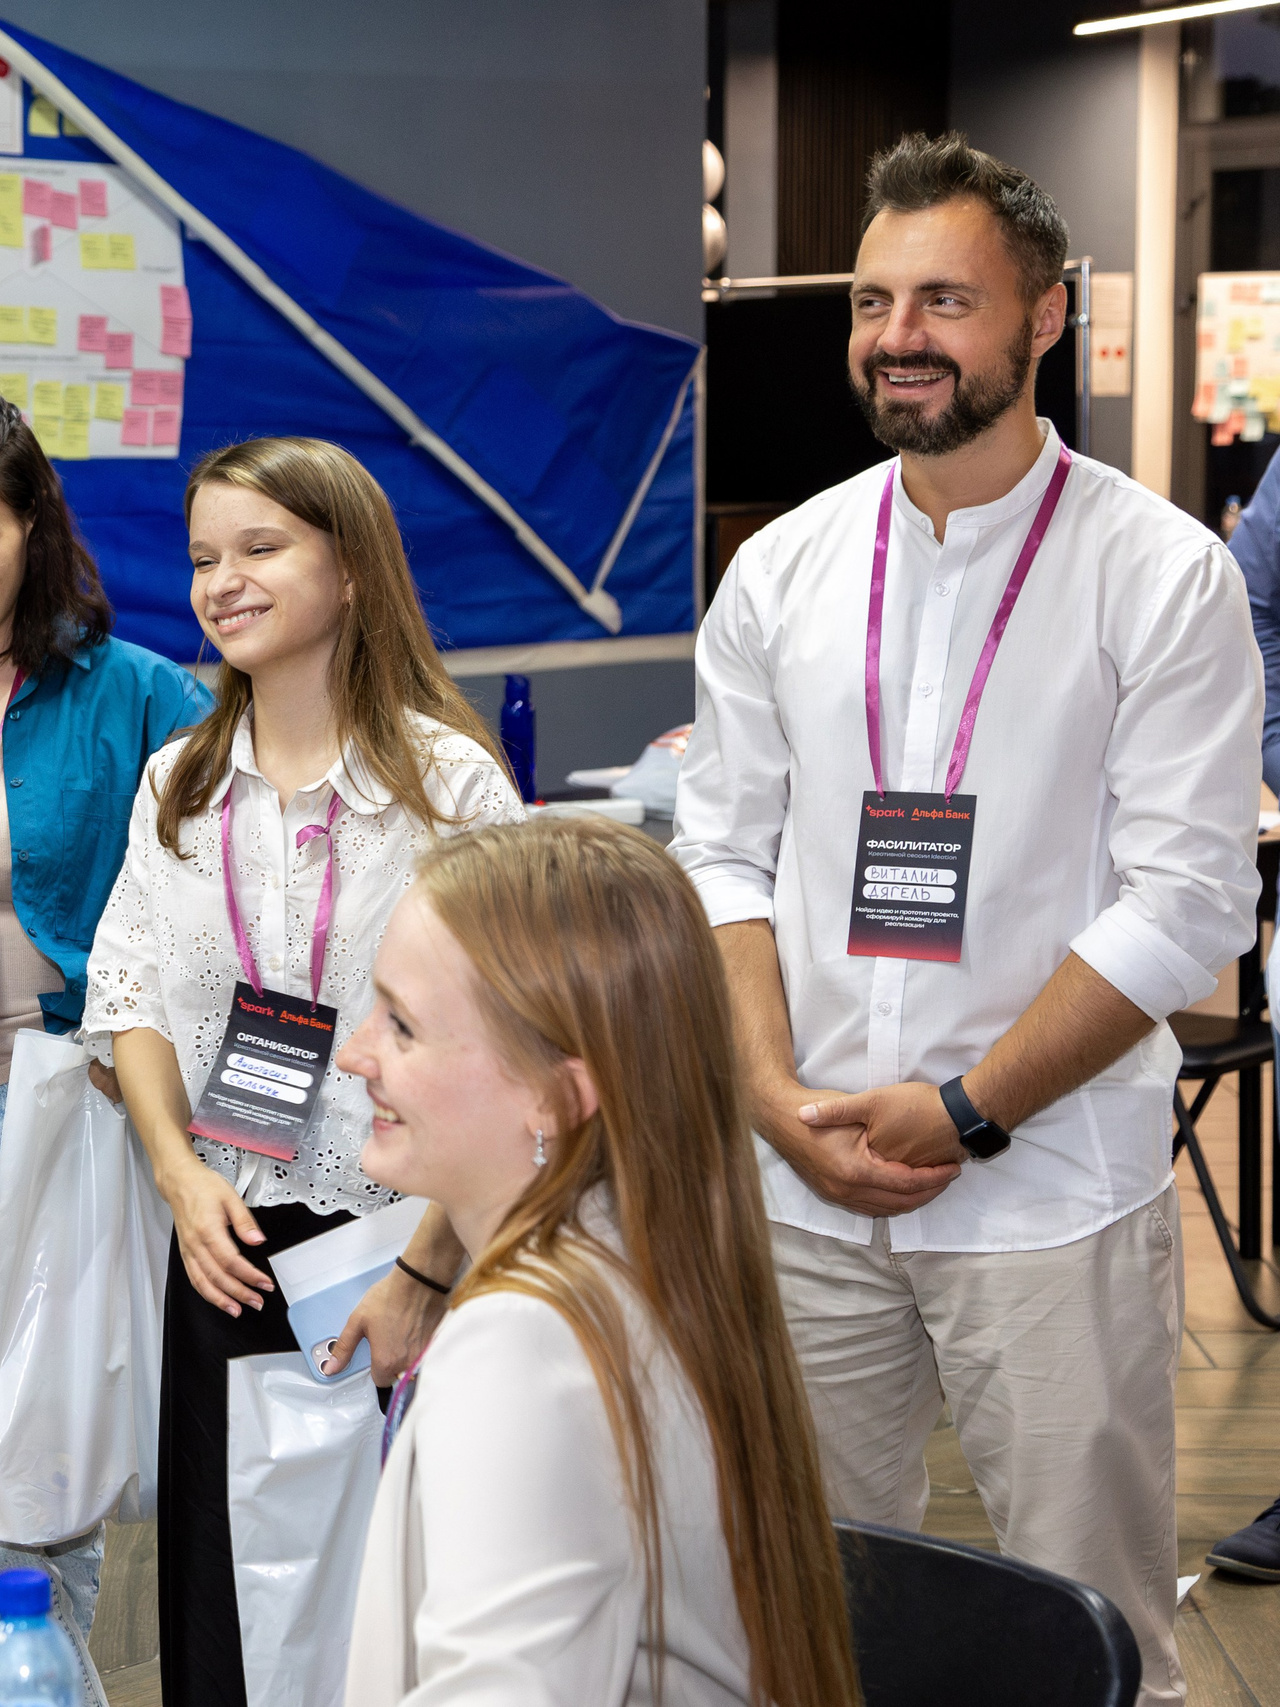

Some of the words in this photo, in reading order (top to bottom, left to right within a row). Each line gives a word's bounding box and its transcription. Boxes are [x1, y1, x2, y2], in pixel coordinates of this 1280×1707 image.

[870, 808, 905, 818] spark
[911, 808, 944, 820] Альфа
[945, 810, 970, 820] Банк
[866, 840, 961, 852] ФАСИЛИТАТОР
[868, 851, 906, 859] Креативной
[871, 867, 939, 883] ВИТАЛИЙ
[868, 885, 930, 900] ДЯГЕЛЬ
[240, 1001, 274, 1017] spark
[279, 1010, 309, 1025] Альфа
[310, 1018, 333, 1032] Банк
[236, 1032, 319, 1060] ОРГАНИЗАТОР
